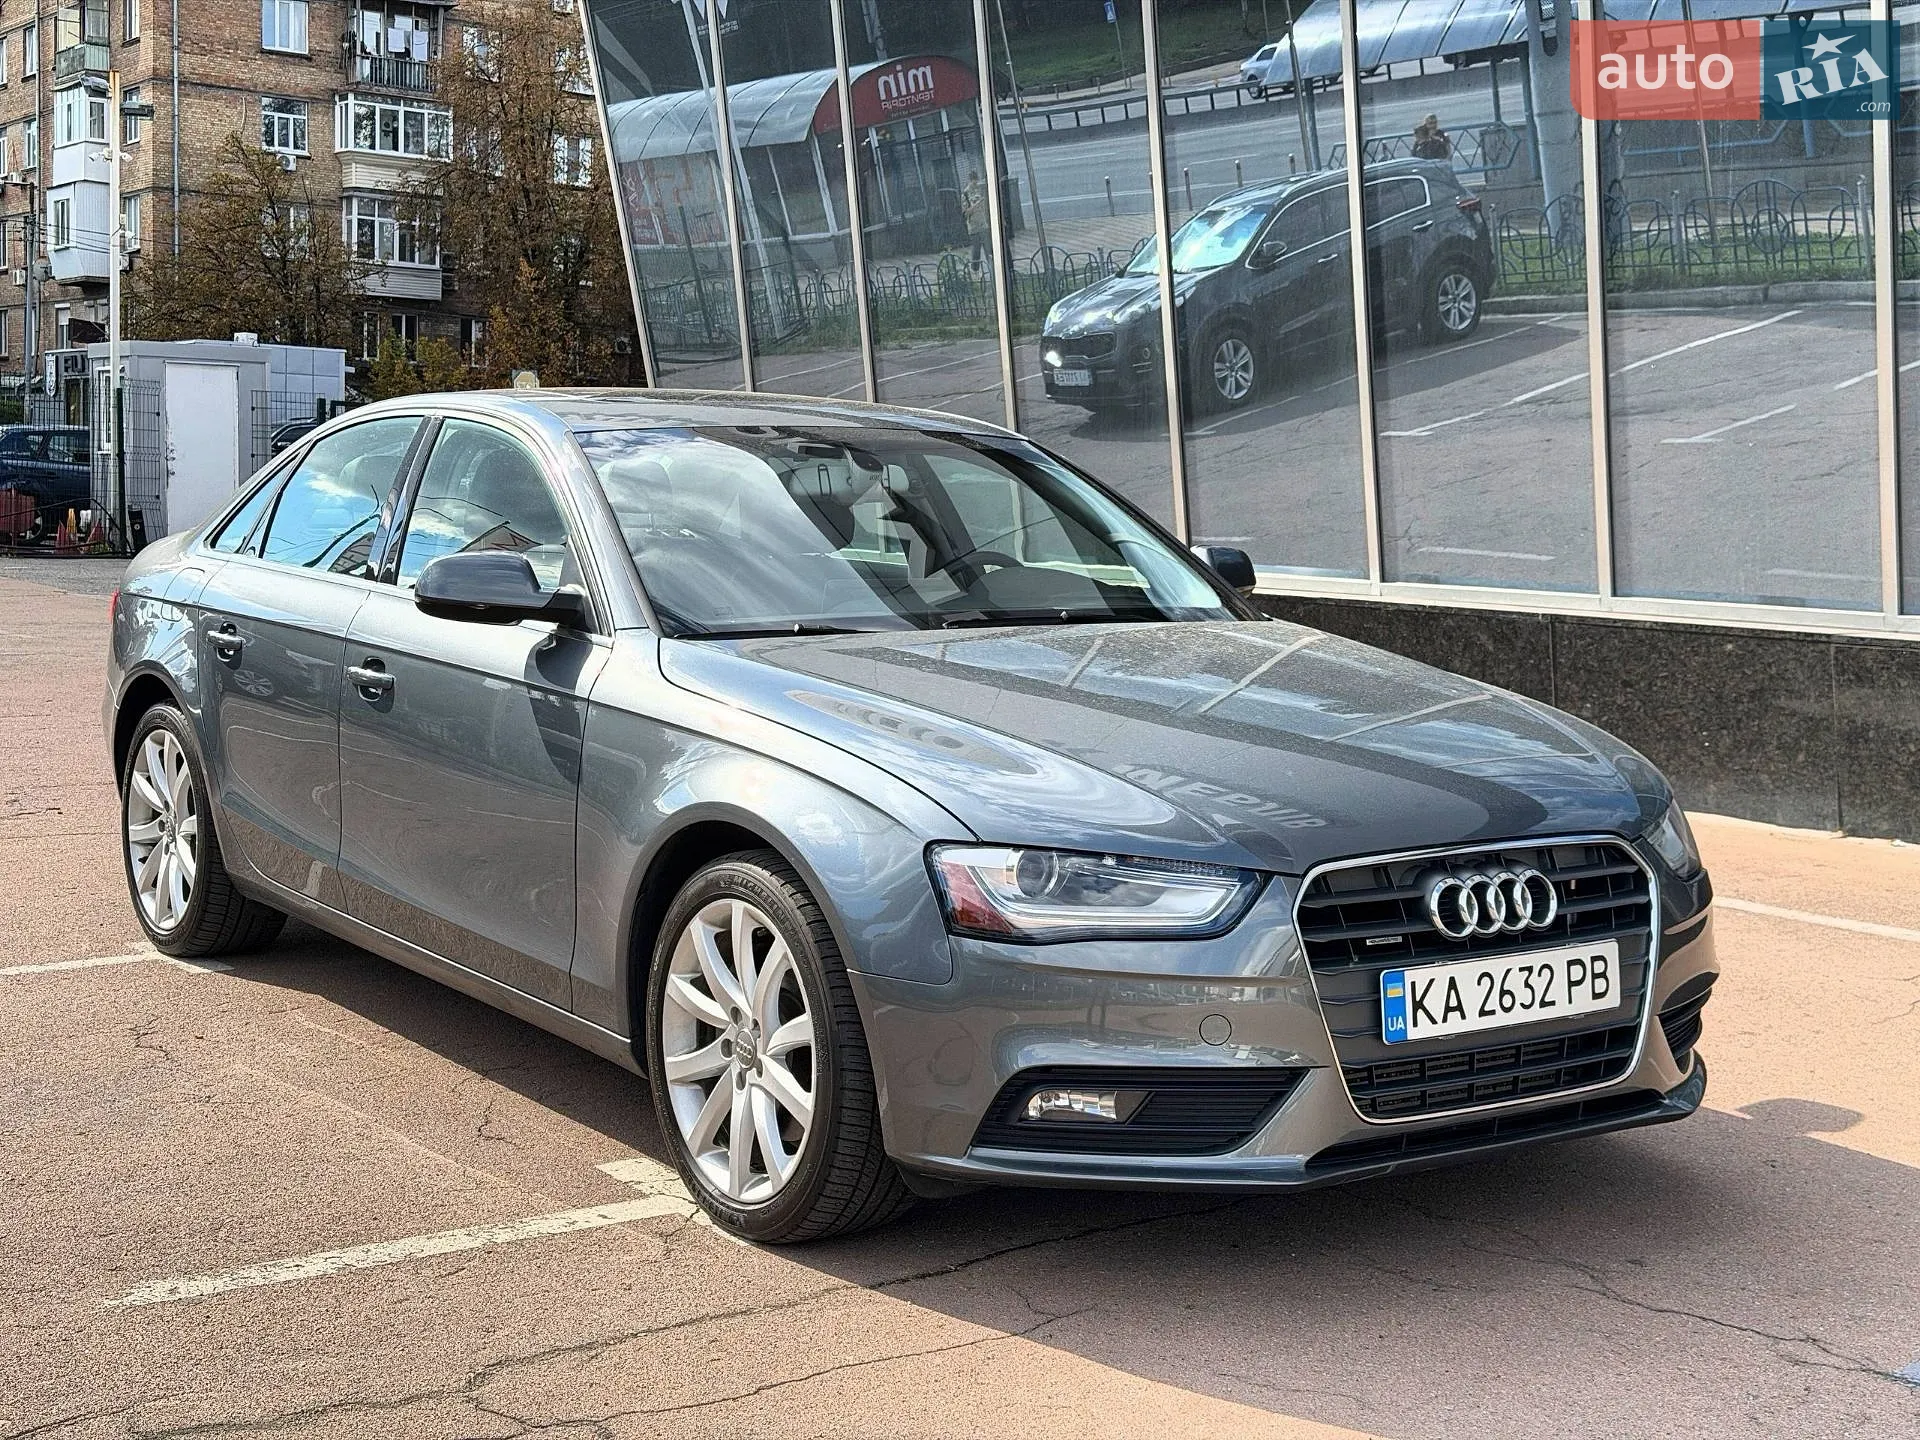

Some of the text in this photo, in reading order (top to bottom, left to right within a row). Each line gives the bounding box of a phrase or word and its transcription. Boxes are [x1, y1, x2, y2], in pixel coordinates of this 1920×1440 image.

[1410, 954, 1610, 1028] KA 2632 PB
[1388, 1015, 1405, 1032] UA
